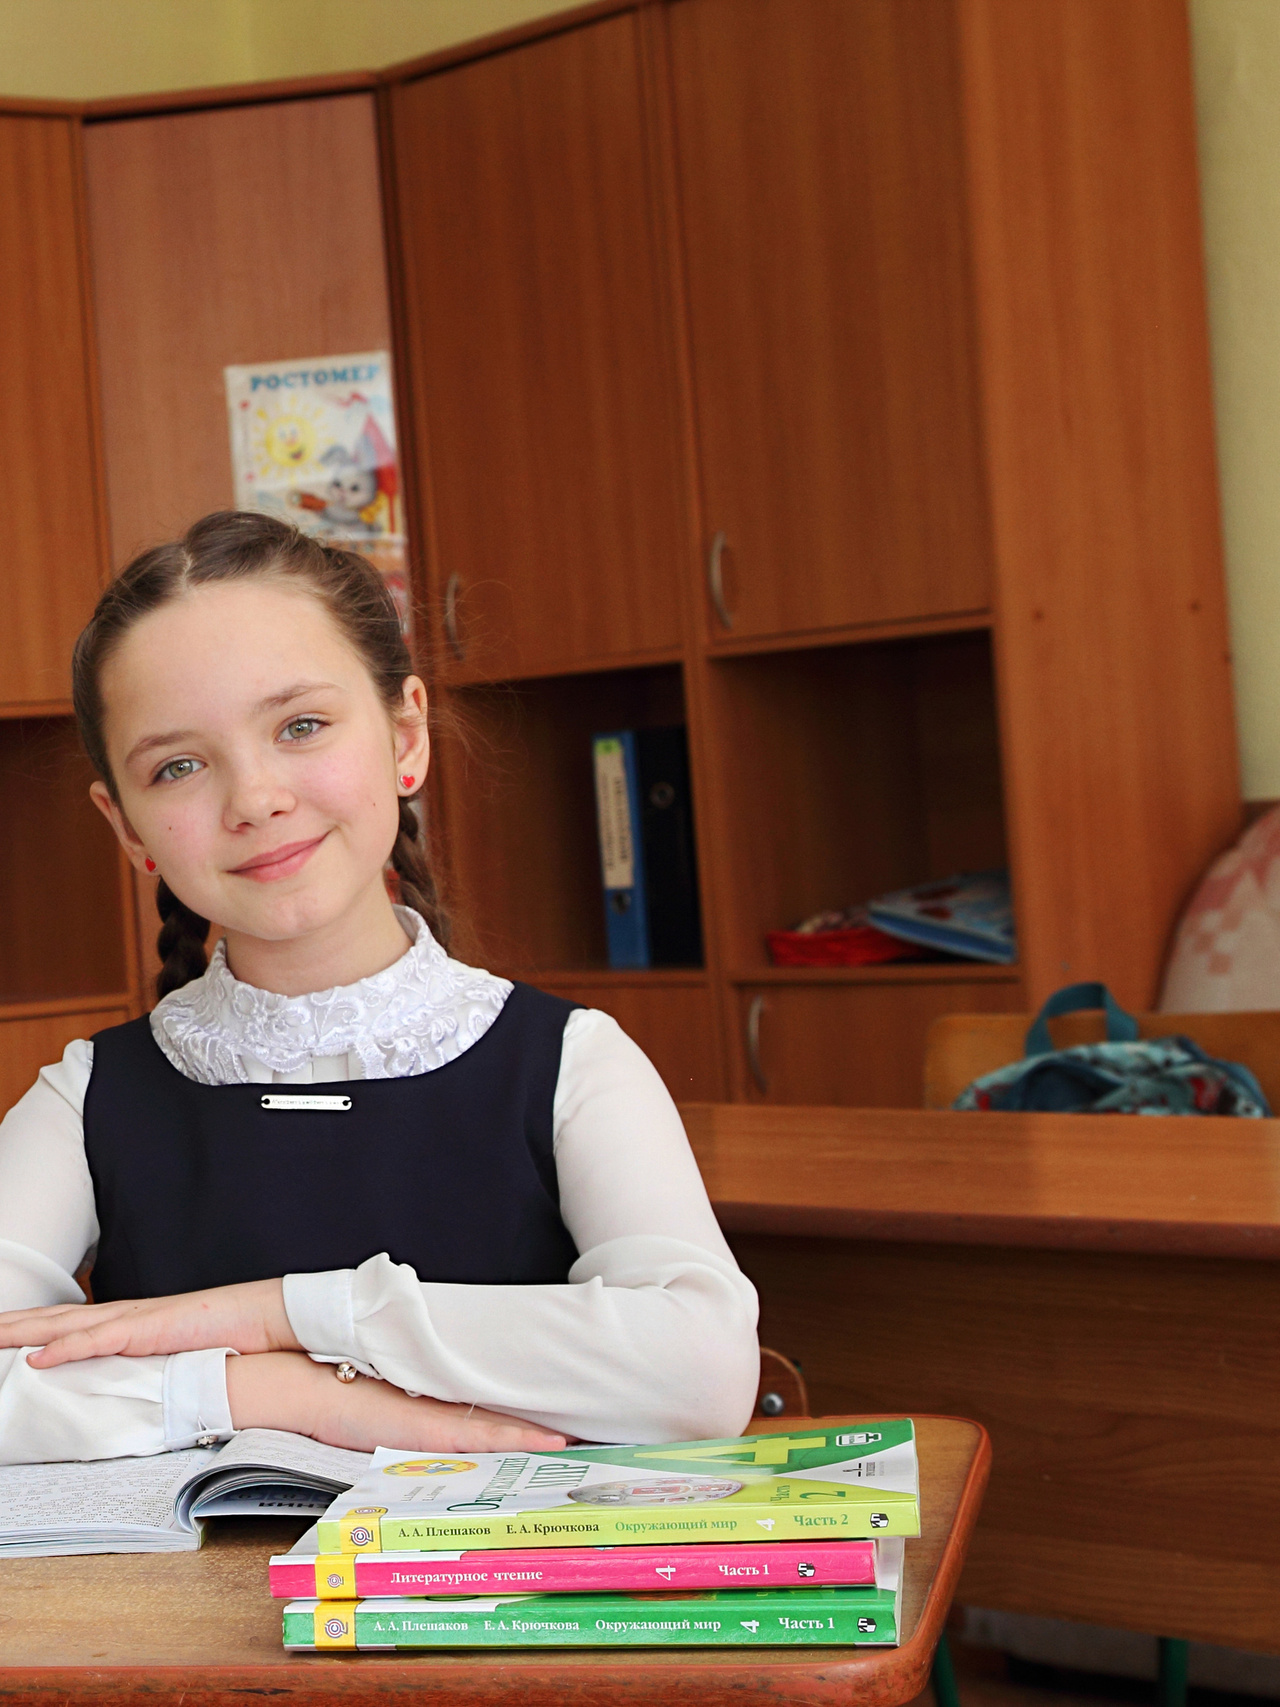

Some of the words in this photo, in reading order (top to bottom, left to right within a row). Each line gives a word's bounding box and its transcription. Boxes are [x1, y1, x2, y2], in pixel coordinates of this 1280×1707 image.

[250, 364, 381, 393] РОСТОМЕР
[633, 1436, 827, 1465] 4
[771, 1484, 790, 1501] Часть
[799, 1490, 846, 1500] 2
[615, 1519, 709, 1533] Окружающий
[711, 1520, 738, 1532] мир
[756, 1518, 775, 1531] 4
[794, 1514, 838, 1528] Часть
[841, 1513, 849, 1526] 2
[398, 1527, 410, 1538] А.
[412, 1527, 424, 1537] А.
[426, 1525, 491, 1538] Плешаков
[506, 1524, 518, 1535] Е.
[520, 1524, 532, 1534] А.
[533, 1523, 600, 1536] Крючкова
[655, 1565, 676, 1581] 4
[719, 1564, 761, 1577] Часть
[763, 1564, 770, 1575] 1
[390, 1571, 488, 1586] Литературное
[493, 1570, 543, 1582] чтение
[373, 1621, 386, 1631] А.
[387, 1621, 400, 1631] А.
[402, 1620, 469, 1632] Плешаков
[483, 1620, 496, 1631] Е.
[497, 1620, 510, 1631] А.
[512, 1619, 580, 1633] Крючкова
[595, 1619, 691, 1634] Окружающий
[694, 1620, 721, 1633] мир
[740, 1619, 760, 1634] 4
[778, 1617, 824, 1630] Часть
[827, 1617, 835, 1629] 1
